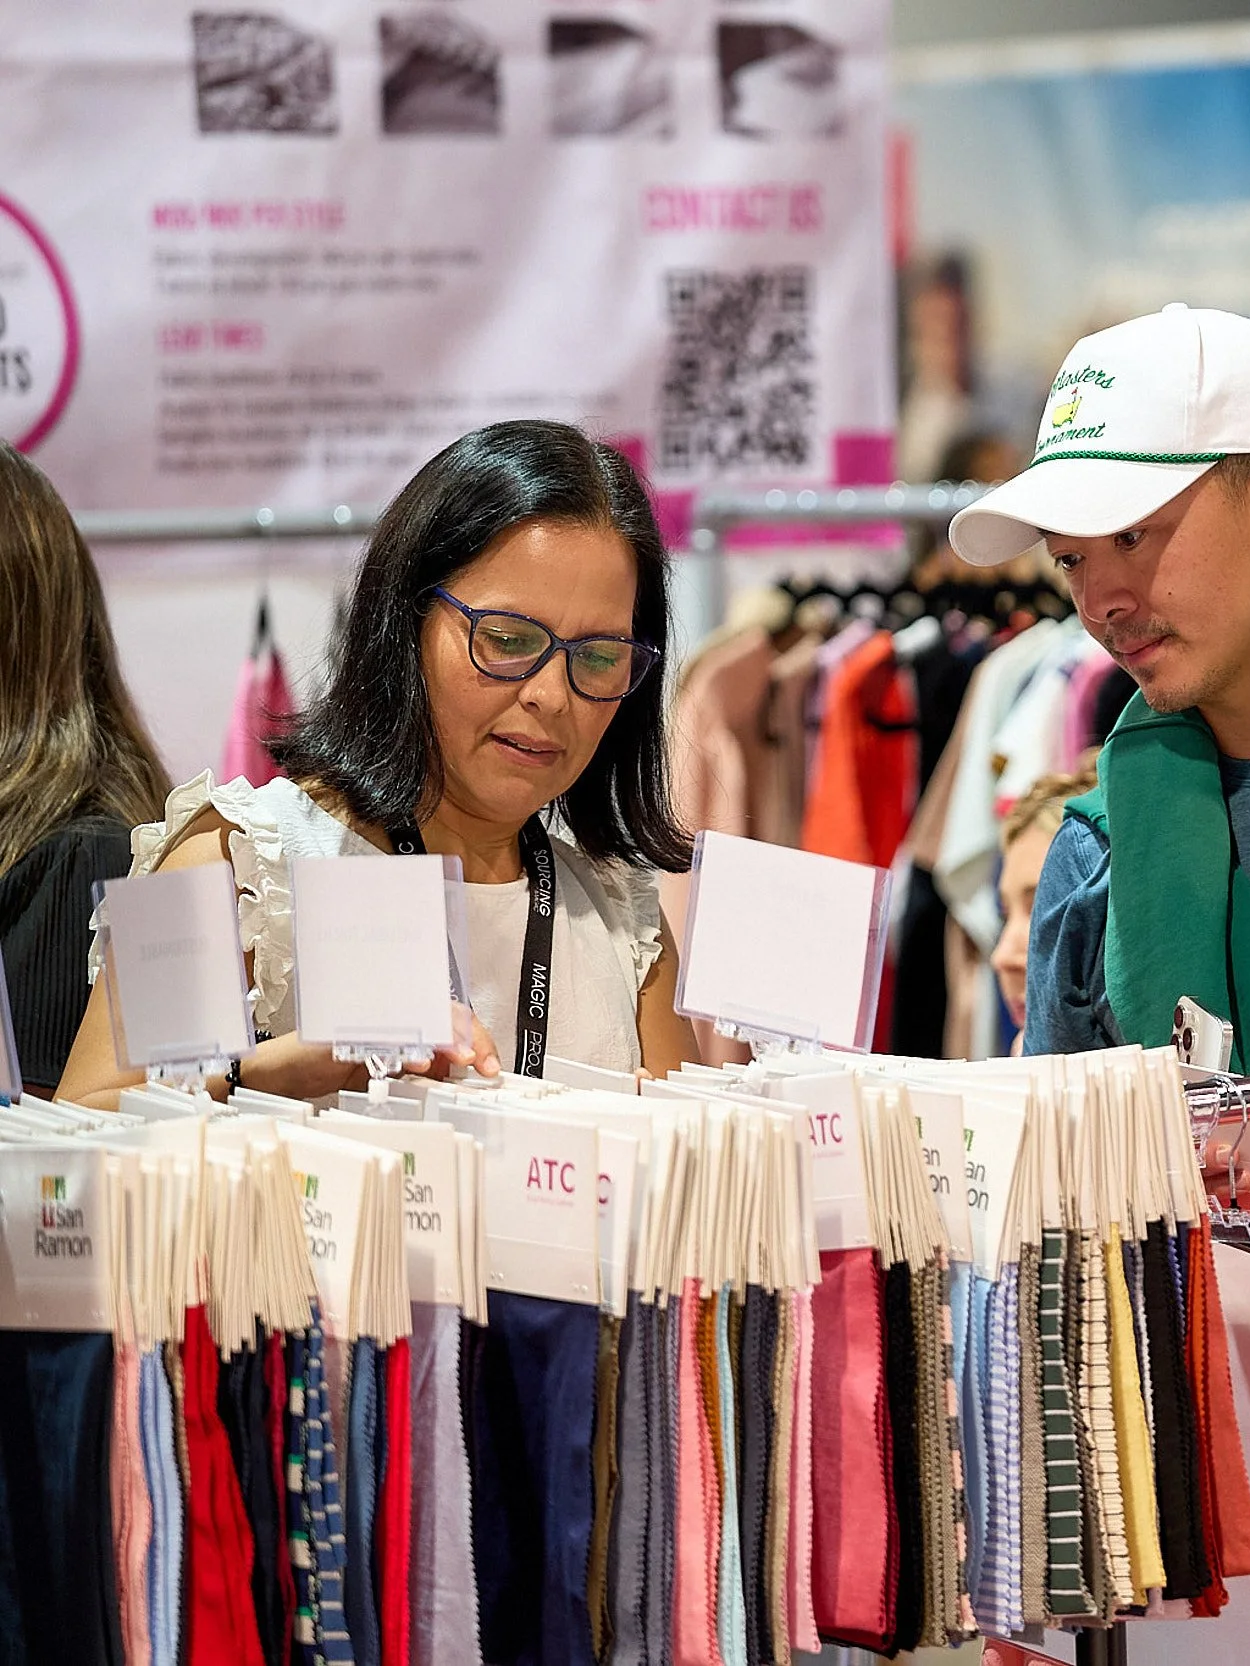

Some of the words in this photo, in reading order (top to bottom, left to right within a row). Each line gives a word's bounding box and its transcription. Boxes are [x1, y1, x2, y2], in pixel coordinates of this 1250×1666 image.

[533, 849, 551, 917] SOURCING
[529, 962, 547, 1019] MAGIC
[526, 1157, 576, 1193] ATC
[404, 1178, 434, 1204] San
[56, 1204, 84, 1230] San
[304, 1201, 333, 1232] San
[35, 1229, 93, 1258] Ramon
